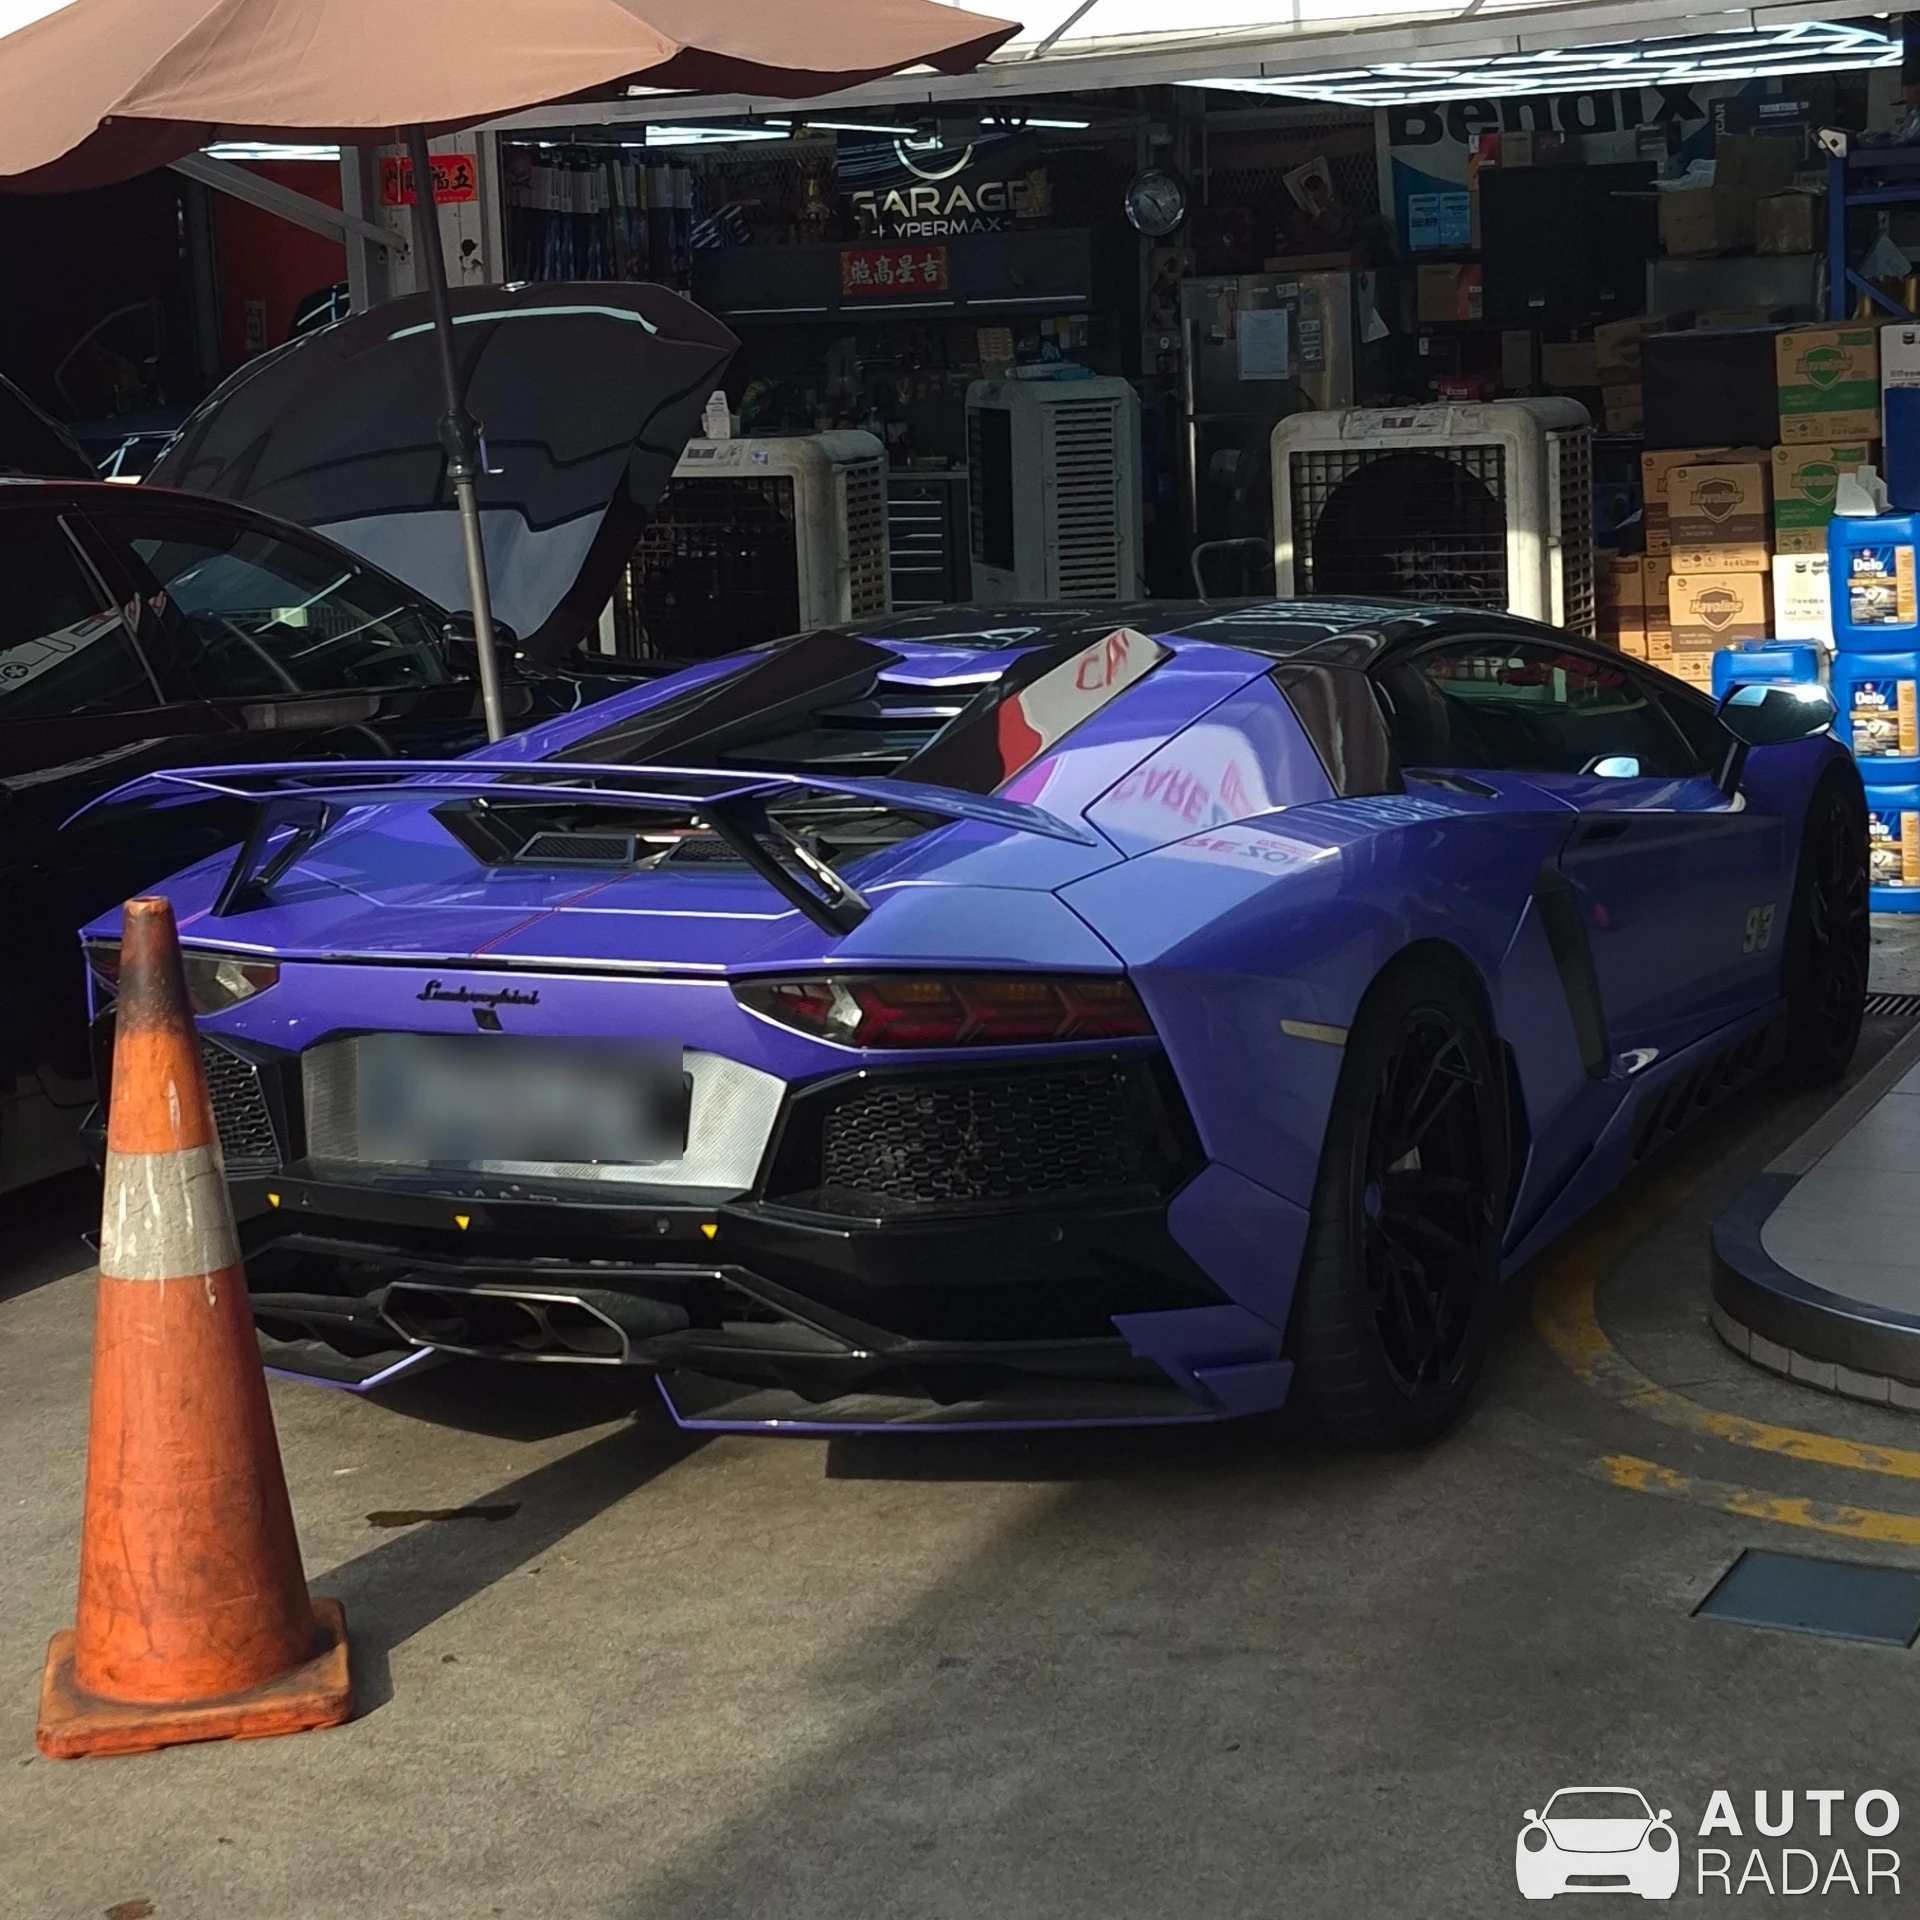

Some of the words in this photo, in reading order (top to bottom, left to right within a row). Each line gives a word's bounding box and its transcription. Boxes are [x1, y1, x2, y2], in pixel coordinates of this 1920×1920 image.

[1388, 84, 1705, 146] Bendix
[1692, 490, 1744, 505] Havoline
[1853, 558, 1883, 572] Delo
[1690, 598, 1743, 614] Havoline
[1855, 691, 1885, 705] Delo
[1869, 821, 1889, 835] elo
[1742, 903, 1776, 954] 93
